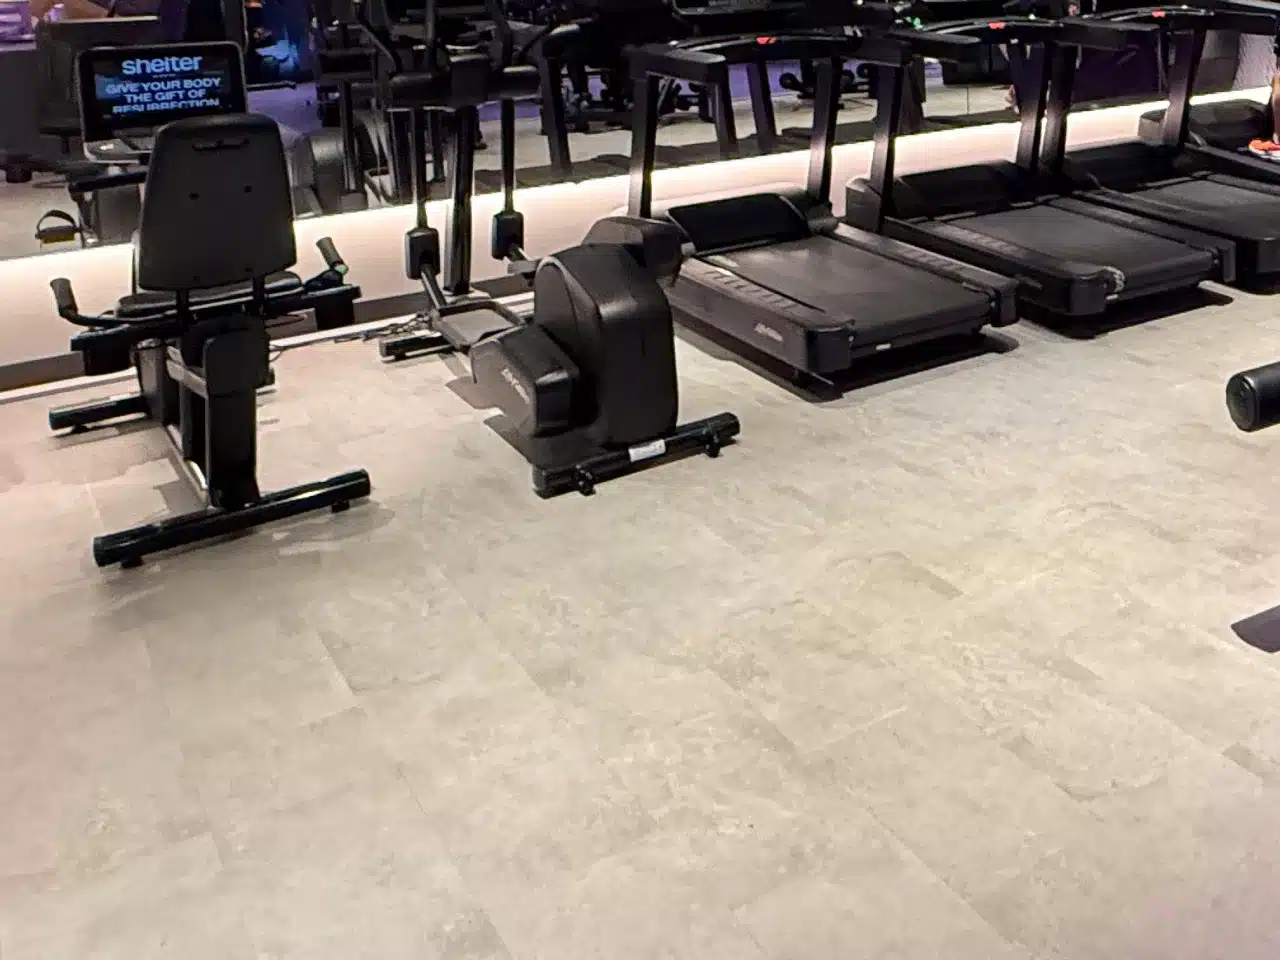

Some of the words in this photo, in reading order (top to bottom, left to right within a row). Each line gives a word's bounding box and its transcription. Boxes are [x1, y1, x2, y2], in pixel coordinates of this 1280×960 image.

[121, 56, 202, 75] shelter
[106, 83, 140, 94] GIVE
[142, 80, 181, 91] YOUR
[183, 77, 221, 89] BODY
[124, 93, 153, 103] THE
[154, 90, 186, 100] GIFT
[187, 88, 207, 98] OF
